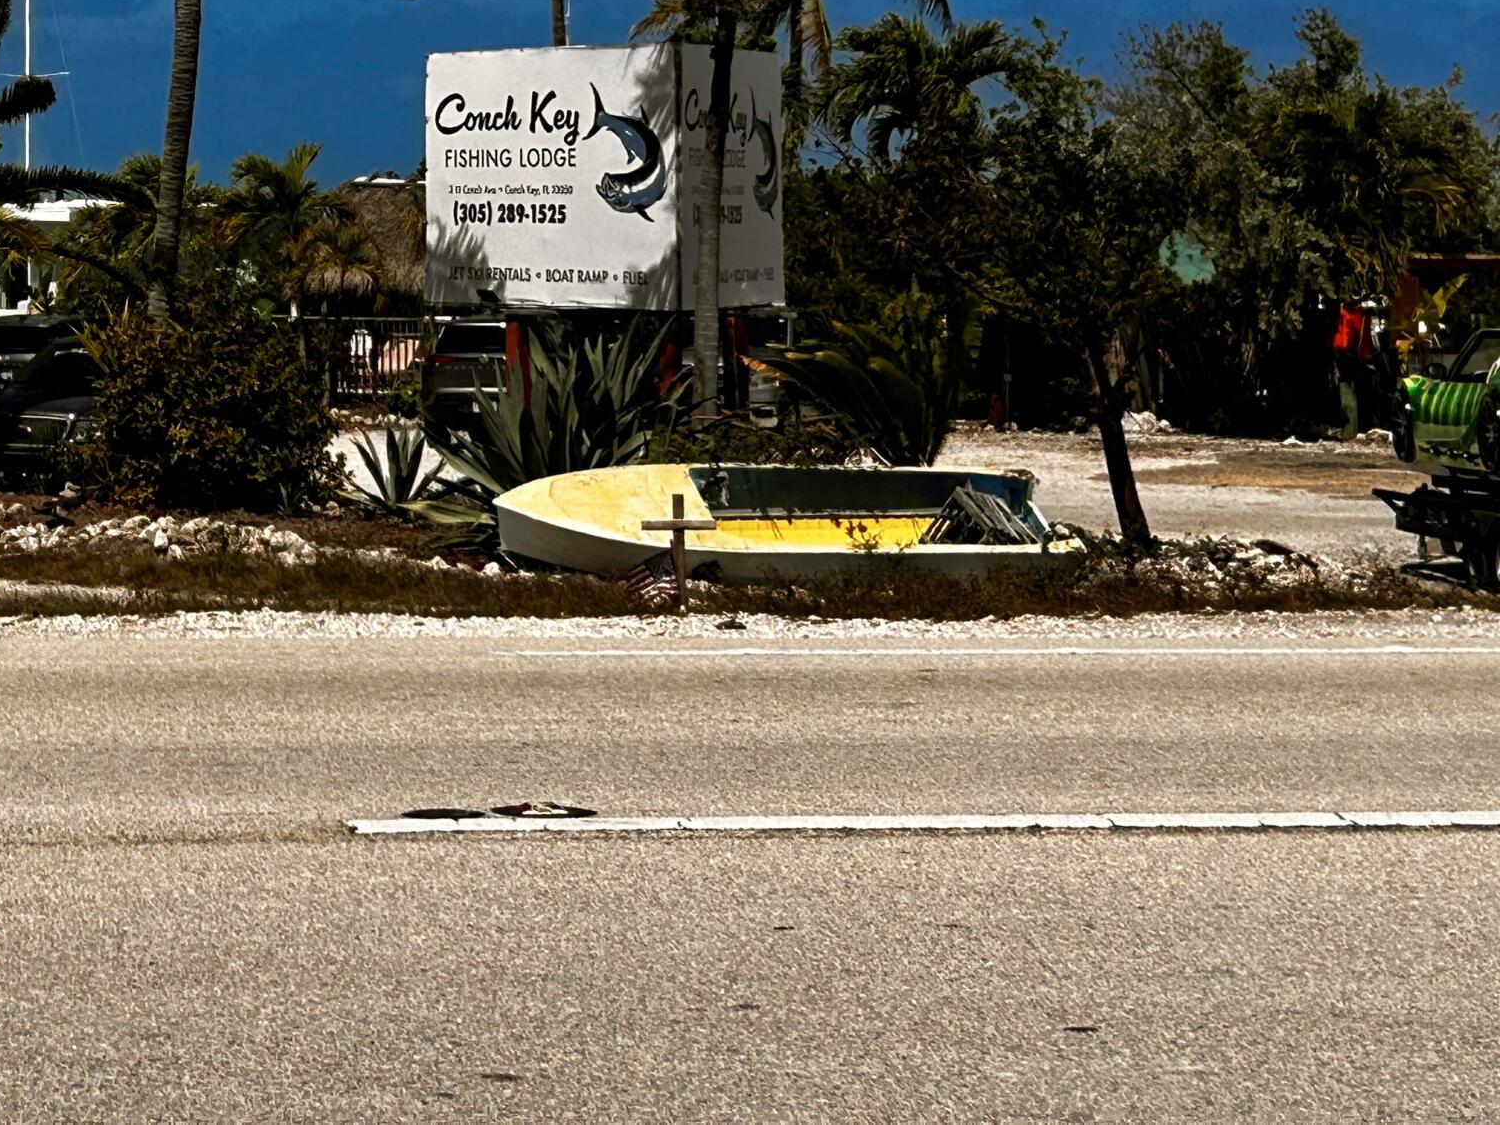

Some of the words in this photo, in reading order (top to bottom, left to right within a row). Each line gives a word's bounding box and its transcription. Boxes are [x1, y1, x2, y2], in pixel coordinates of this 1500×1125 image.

[435, 93, 522, 135] Conch
[529, 90, 580, 146] Key
[445, 148, 512, 168] FISHING
[519, 148, 577, 168] LODGE
[453, 200, 492, 226] (305)
[497, 203, 567, 224] 289-1525
[449, 266, 466, 280] JET
[485, 267, 531, 282] RENTALS
[545, 268, 574, 283] BOAT
[577, 269, 608, 284] RAMP
[623, 271, 650, 286] FUEL
